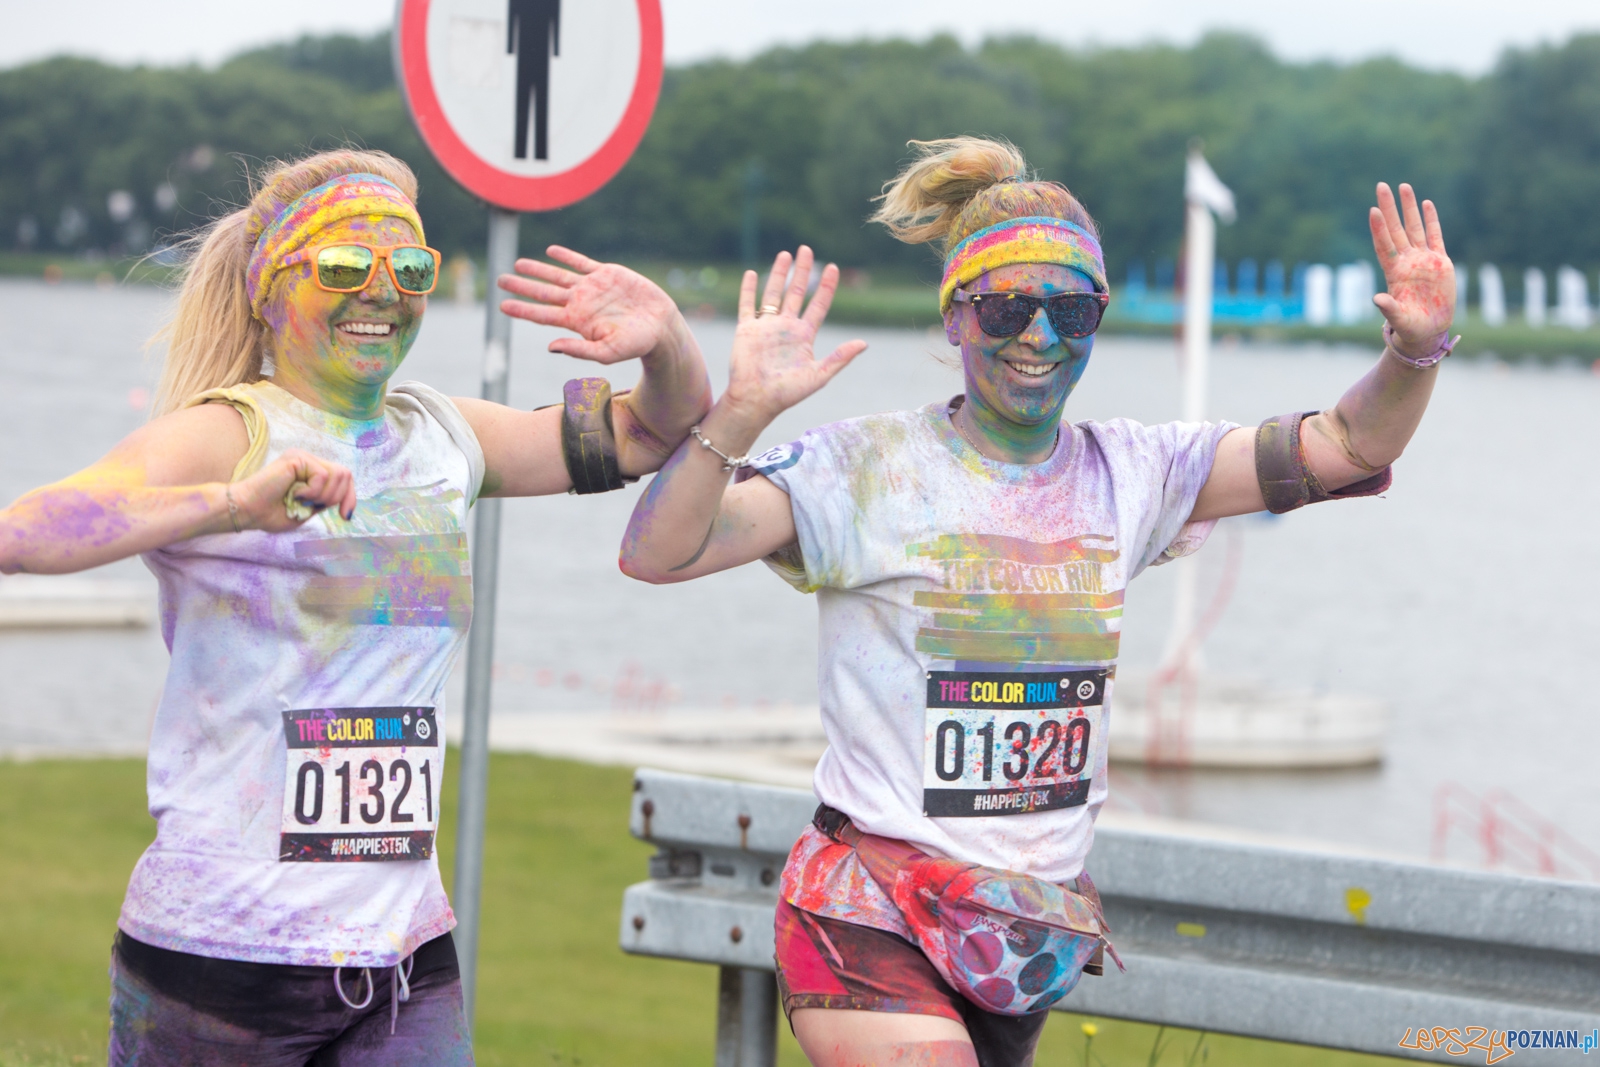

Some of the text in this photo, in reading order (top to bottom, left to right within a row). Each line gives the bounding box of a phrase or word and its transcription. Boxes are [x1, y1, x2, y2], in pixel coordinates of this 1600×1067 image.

[939, 559, 985, 590] THE
[987, 559, 1065, 592] COLOR
[938, 680, 1058, 703] THE COLOR RUN
[295, 717, 403, 741] THE COLOR RUN
[935, 717, 1091, 782] 01320
[294, 758, 432, 825] 01321
[973, 788, 1049, 811] #HAPPIEST5K
[331, 836, 411, 856] #HAPPIEST5K
